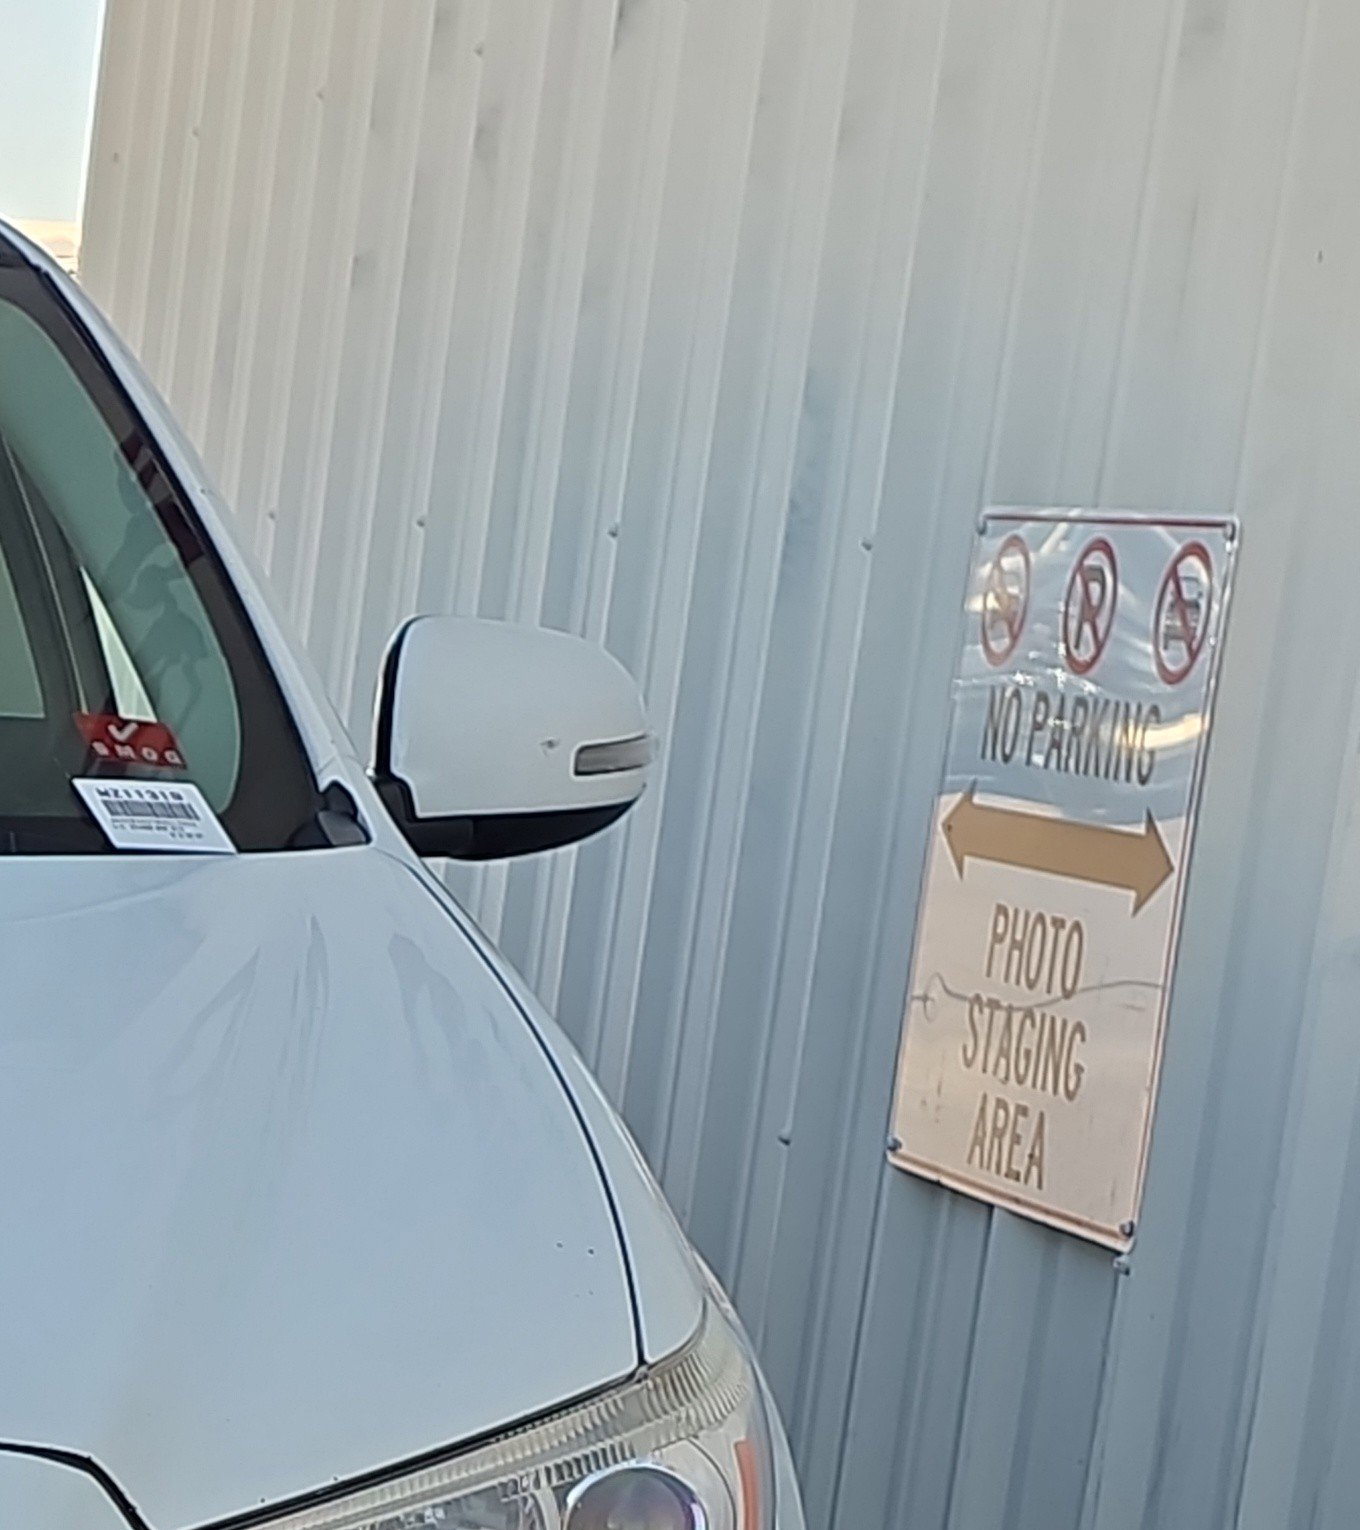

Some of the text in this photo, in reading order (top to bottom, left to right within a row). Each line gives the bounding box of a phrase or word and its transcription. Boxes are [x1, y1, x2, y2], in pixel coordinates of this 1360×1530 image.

[981, 686, 1162, 786] NO PARKING
[986, 902, 1084, 999] PHOTO
[962, 993, 1086, 1103] STAGING
[967, 1093, 1044, 1191] AREA
